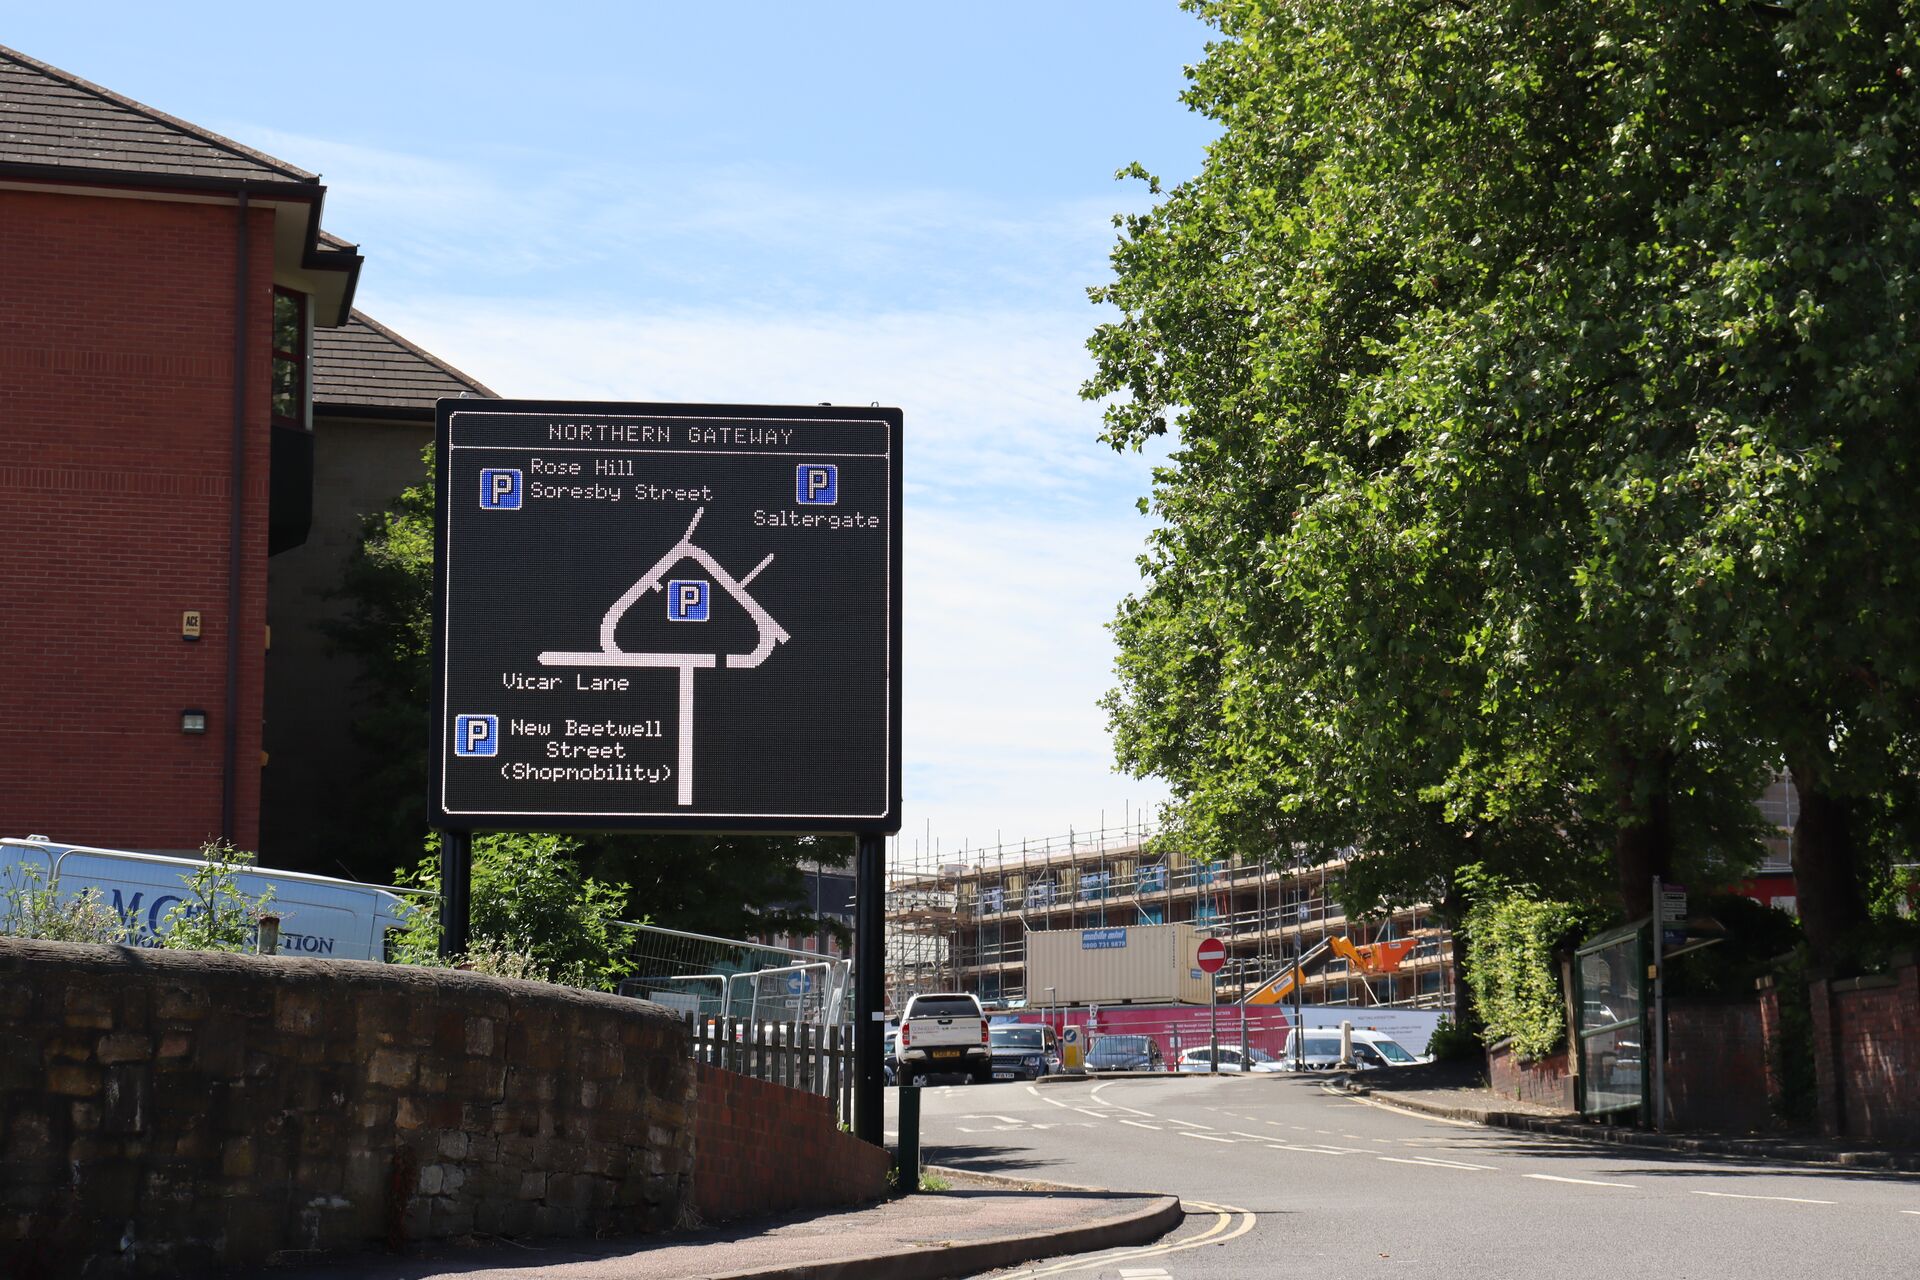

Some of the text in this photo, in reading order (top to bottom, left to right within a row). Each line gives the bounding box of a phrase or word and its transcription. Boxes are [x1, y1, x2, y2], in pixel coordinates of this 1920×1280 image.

[549, 423, 793, 445] NORTHERN GATEWAY
[531, 457, 634, 476] Rose Hill
[492, 474, 512, 505] P
[530, 481, 713, 502] Soresby Street
[807, 468, 828, 500] P
[753, 509, 880, 530] Saltergate
[679, 585, 700, 617] P
[185, 615, 199, 627] ACE
[502, 672, 630, 691] Vicar Lane
[467, 720, 488, 752] P
[511, 718, 663, 738] New Beetwell
[546, 741, 627, 759] Street
[501, 762, 671, 784] (Shopmobility)
